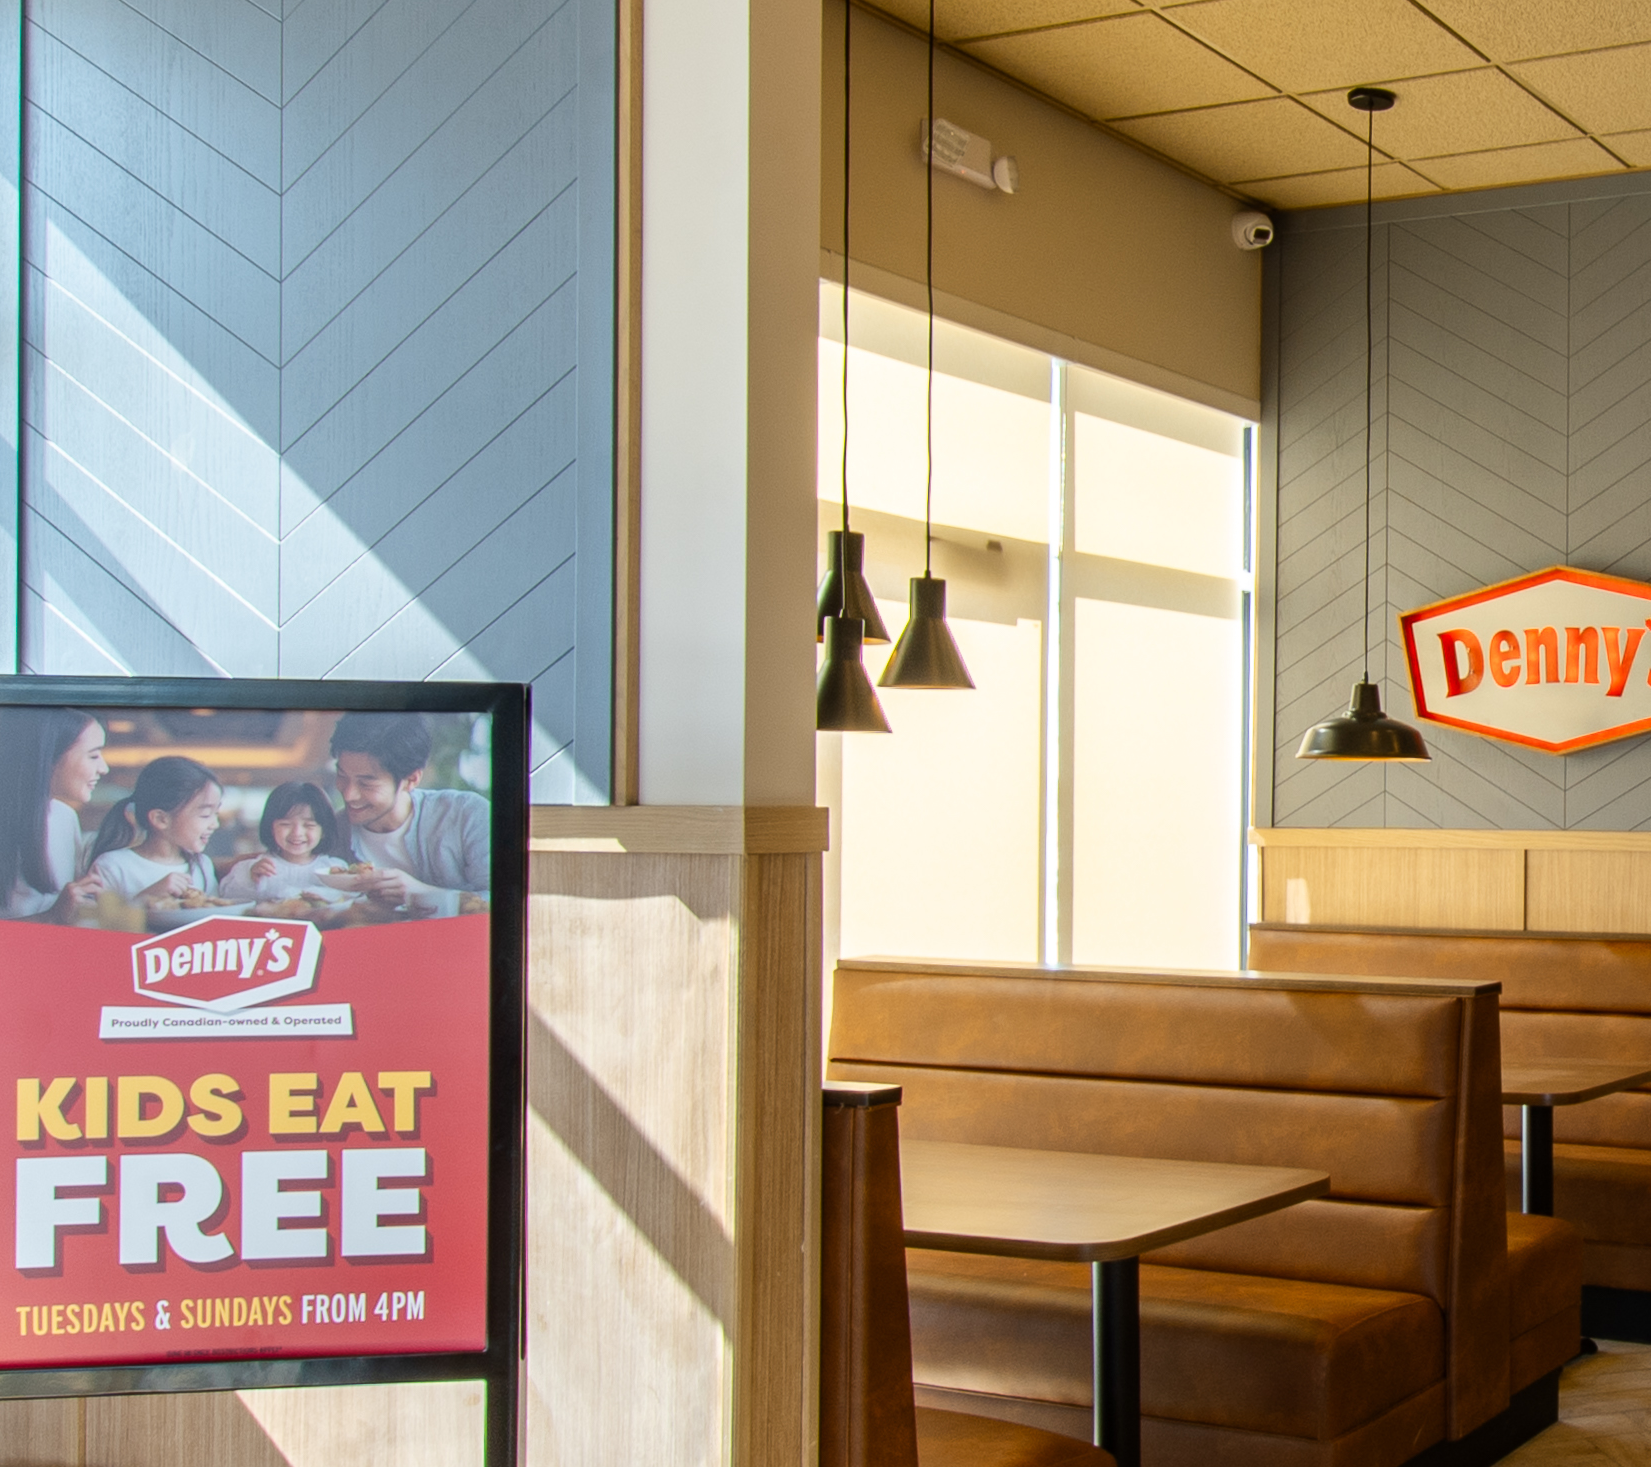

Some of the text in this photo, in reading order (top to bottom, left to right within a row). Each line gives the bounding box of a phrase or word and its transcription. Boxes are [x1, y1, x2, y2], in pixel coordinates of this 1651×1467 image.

[143, 928, 294, 984] Denny's
[111, 1015, 342, 1029] Proudly Canadian-owned & Operated
[16, 1071, 431, 1141] KIDS EAT
[15, 1147, 427, 1269] FREE
[16, 1291, 426, 1336] TUESDAYS & SUNDAYS FROM 4PM
